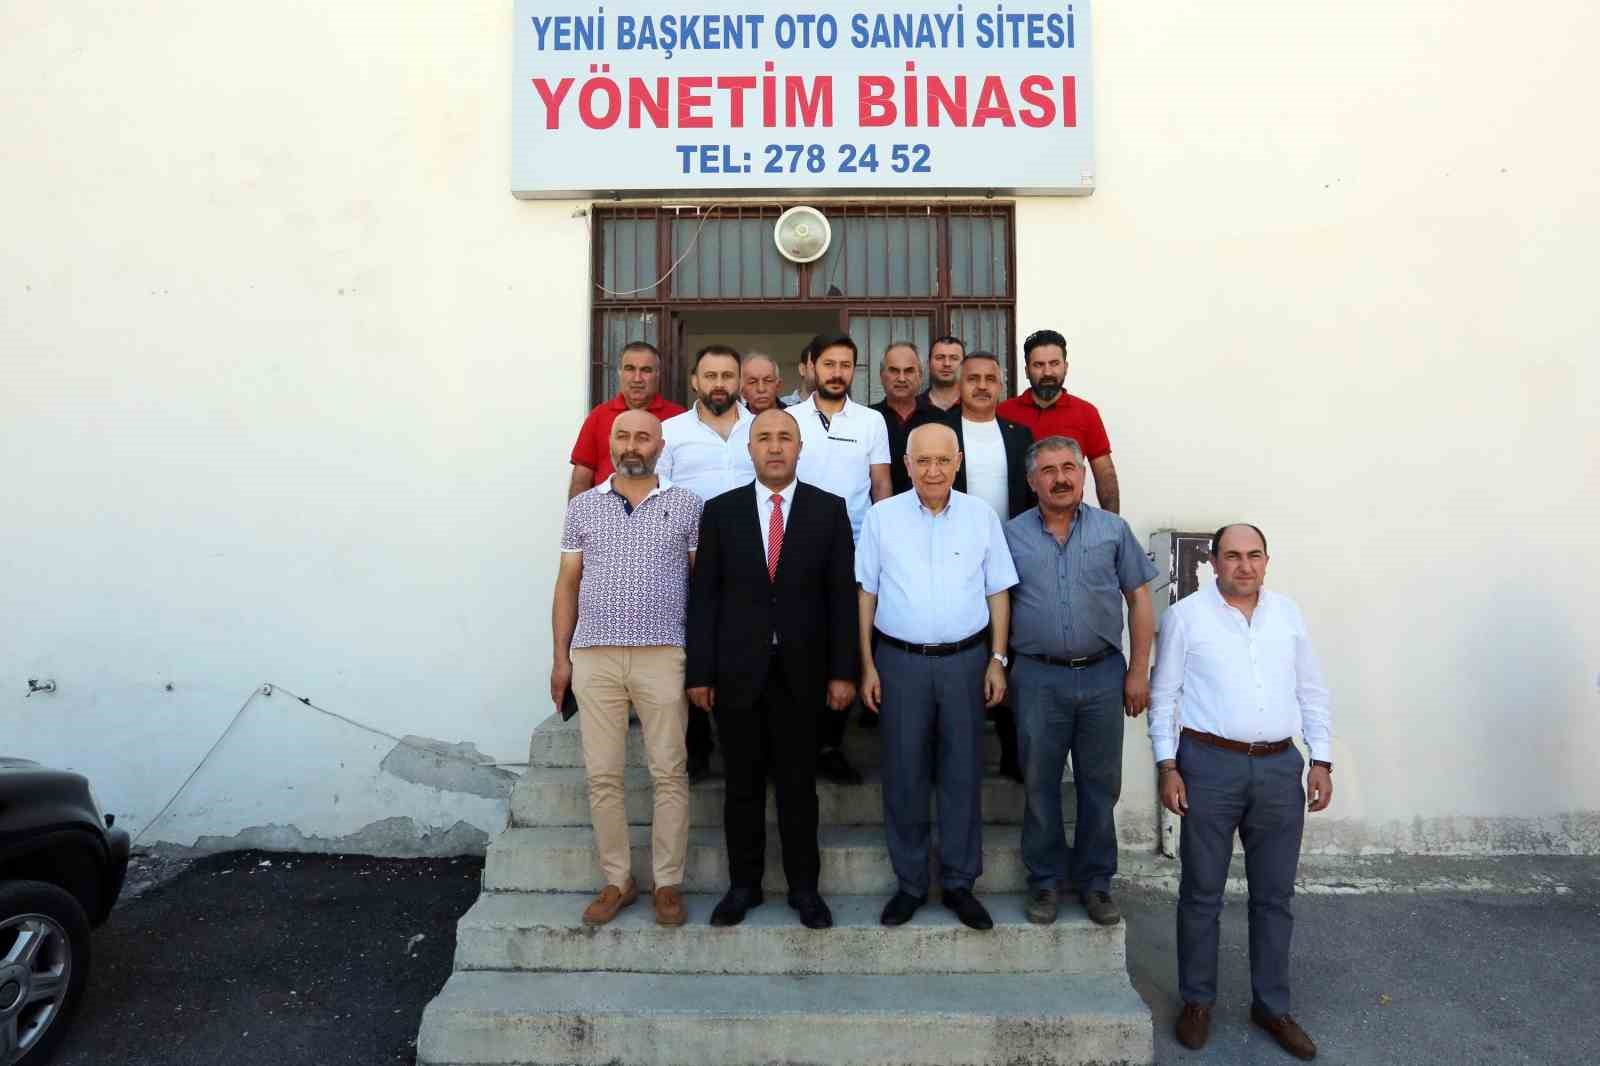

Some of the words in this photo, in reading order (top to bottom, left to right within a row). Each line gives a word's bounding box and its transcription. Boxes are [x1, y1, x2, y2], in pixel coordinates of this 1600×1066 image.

[531, 6, 605, 50] YENİ
[617, 15, 764, 59] BAŞKENT
[775, 14, 838, 49] OTO
[850, 4, 965, 49] SANAYİ
[975, 4, 1075, 49] SİTESİ
[532, 61, 833, 129] YÖNETİM
[858, 61, 1077, 128] BİNASI
[676, 144, 752, 174] TEL:
[765, 143, 826, 173] 278
[838, 143, 879, 173] 24
[892, 143, 930, 173] 52
